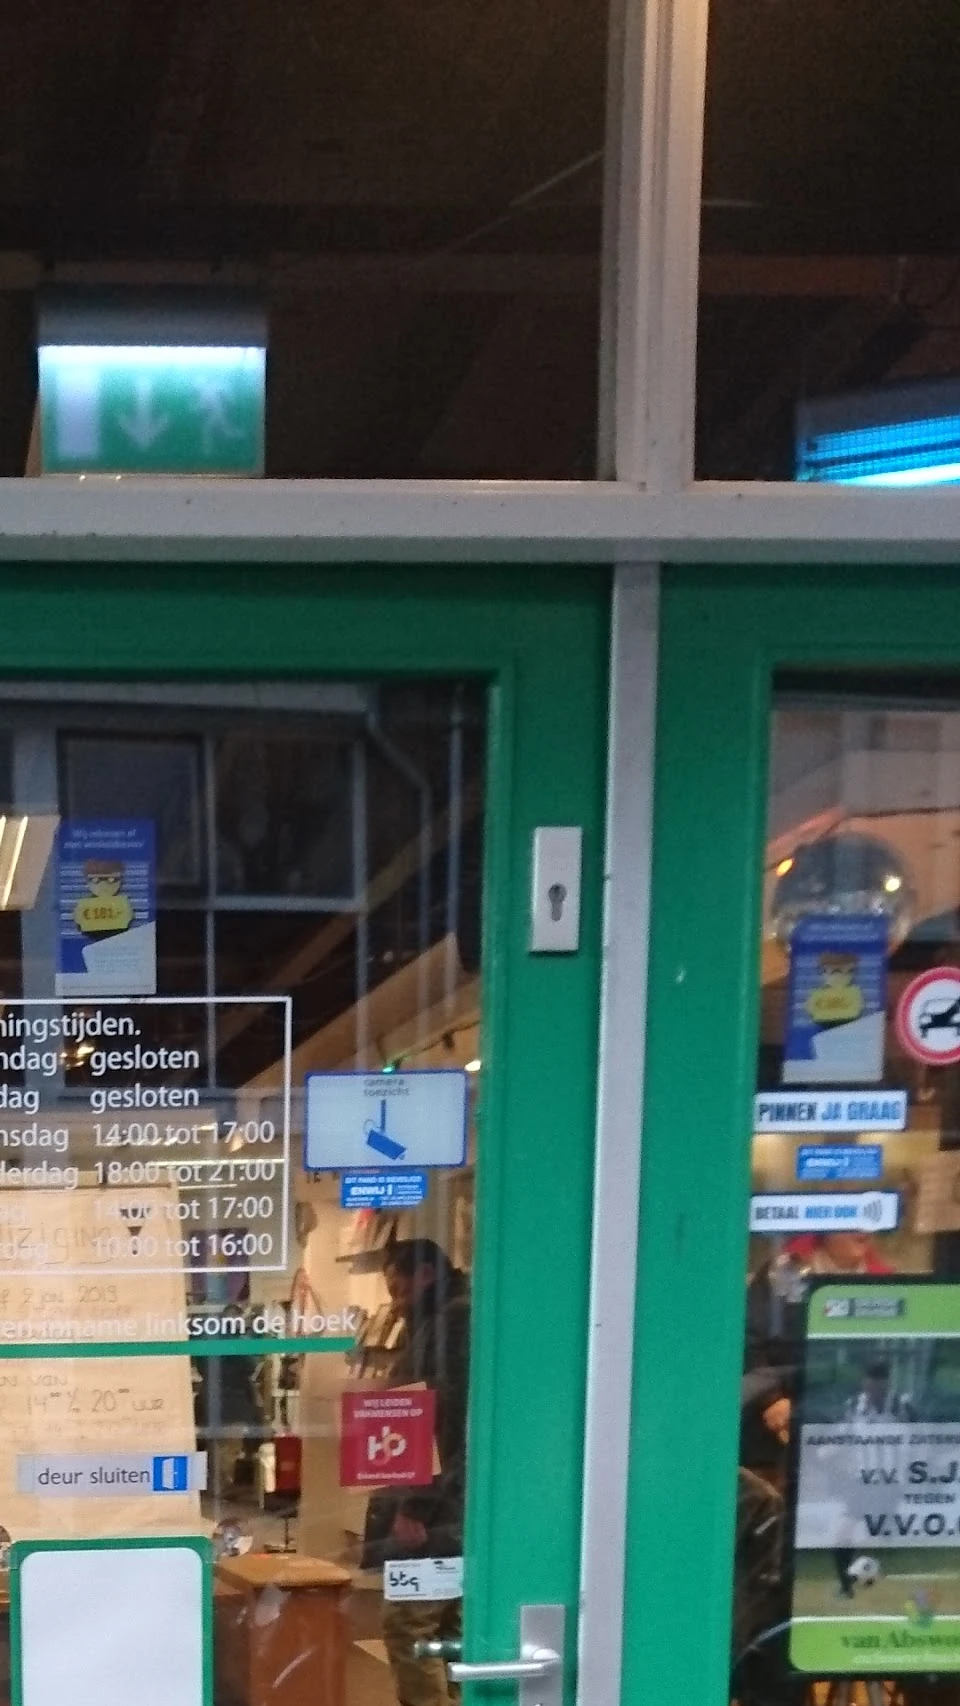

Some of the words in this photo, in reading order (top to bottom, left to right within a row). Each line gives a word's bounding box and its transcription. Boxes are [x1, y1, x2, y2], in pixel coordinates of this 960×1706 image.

[90, 1044, 200, 1077] gesloten
[90, 1083, 200, 1114] gesloten
[759, 1102, 817, 1121] PINNEN
[93, 1124, 158, 1147] 14:00
[166, 1124, 200, 1145] tot
[211, 1121, 275, 1144] 17:00
[95, 1161, 160, 1183] 18:00
[169, 1162, 201, 1183] tot
[209, 1160, 276, 1182] 21:00
[167, 1199, 200, 1220] tot
[210, 1196, 274, 1219] 17:00
[171, 1236, 200, 1257] tot
[209, 1233, 273, 1256] 16:00
[146, 1309, 246, 1336] linksom
[253, 1310, 286, 1334] de
[293, 1307, 357, 1332] hoek
[37, 1467, 83, 1485] deur
[90, 1466, 151, 1484] sluiten
[863, 1513, 960, 1537] V.V.O.
